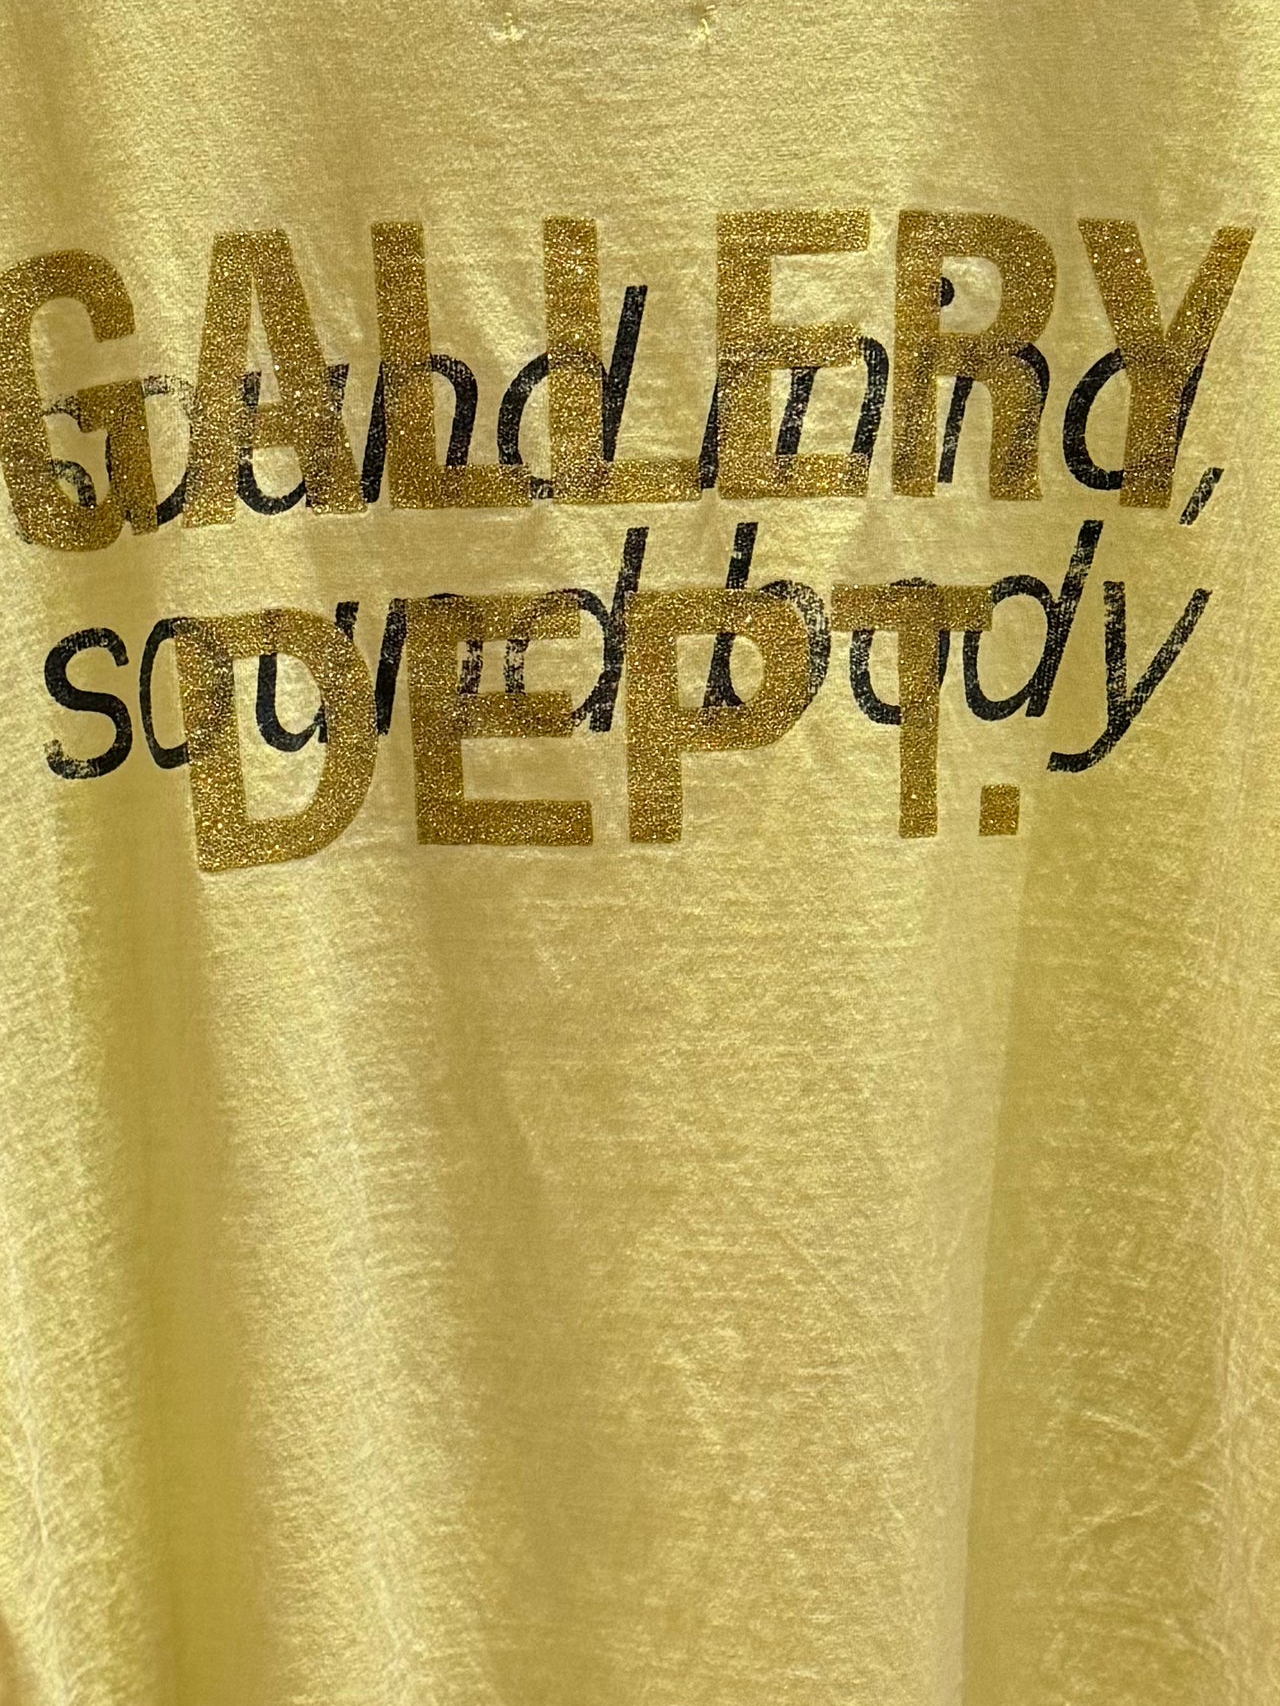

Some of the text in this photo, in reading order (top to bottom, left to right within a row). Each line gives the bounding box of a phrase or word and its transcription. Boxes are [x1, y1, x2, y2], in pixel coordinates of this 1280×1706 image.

[43, 519, 1213, 779] sound body
[172, 584, 1021, 871] DEPT.
